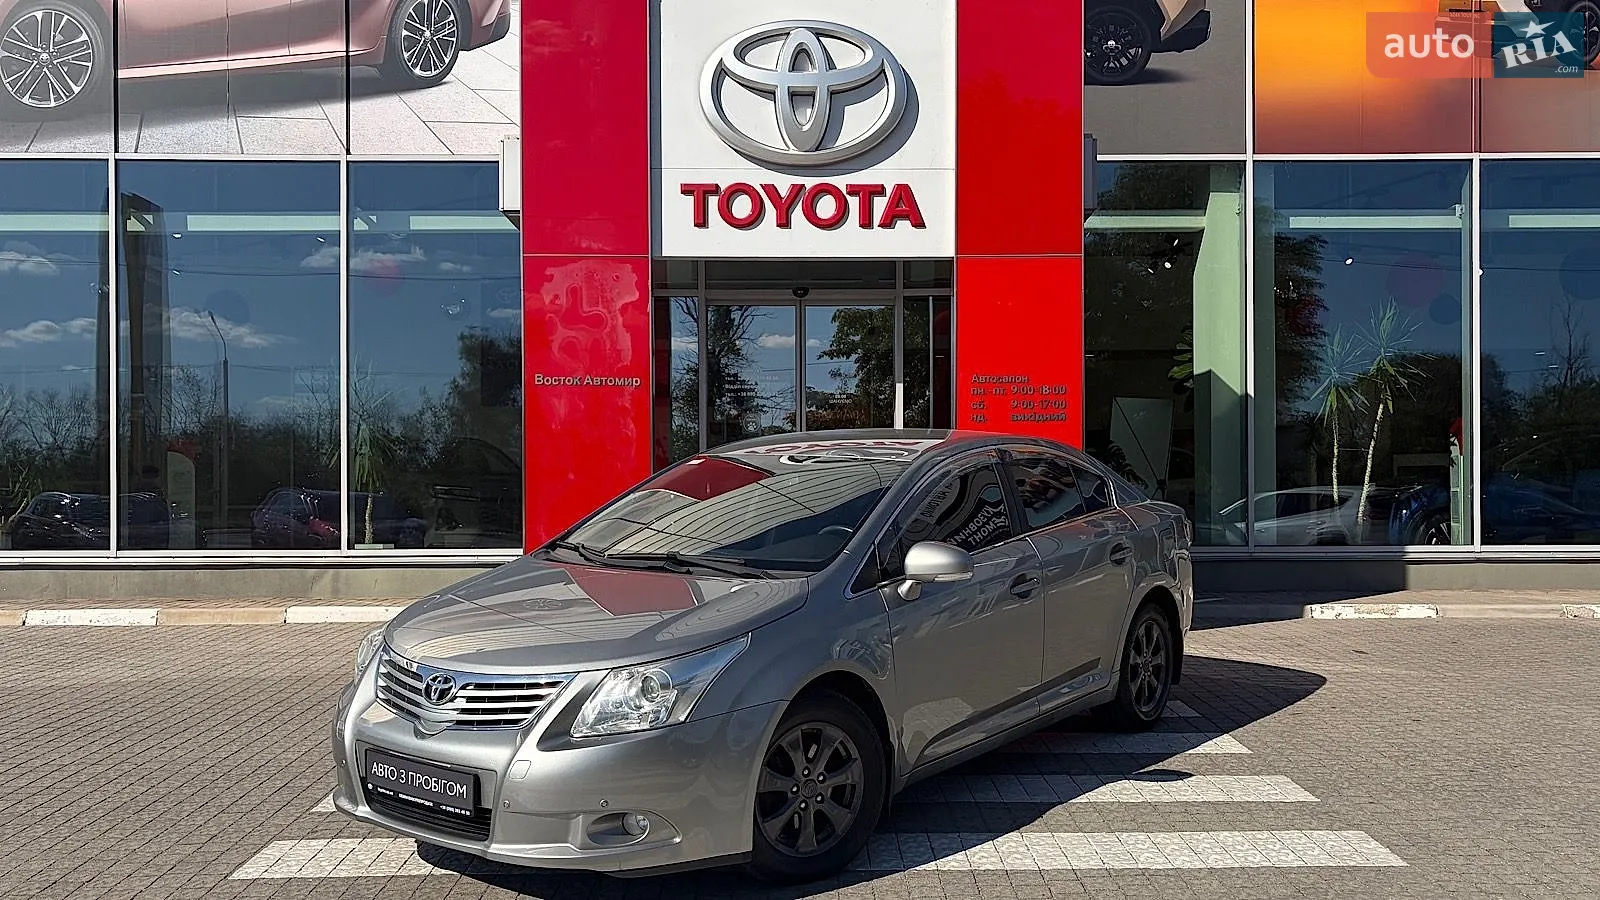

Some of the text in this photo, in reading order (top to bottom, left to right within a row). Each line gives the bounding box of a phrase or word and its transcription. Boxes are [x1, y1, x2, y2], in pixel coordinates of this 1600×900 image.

[680, 182, 926, 229] TOYOTA
[534, 374, 641, 388] Восток Автомир
[971, 374, 1029, 383] Автосалон
[371, 761, 398, 781] АВТО
[399, 769, 406, 784] З
[408, 772, 467, 799] ПРОБІГОМ
